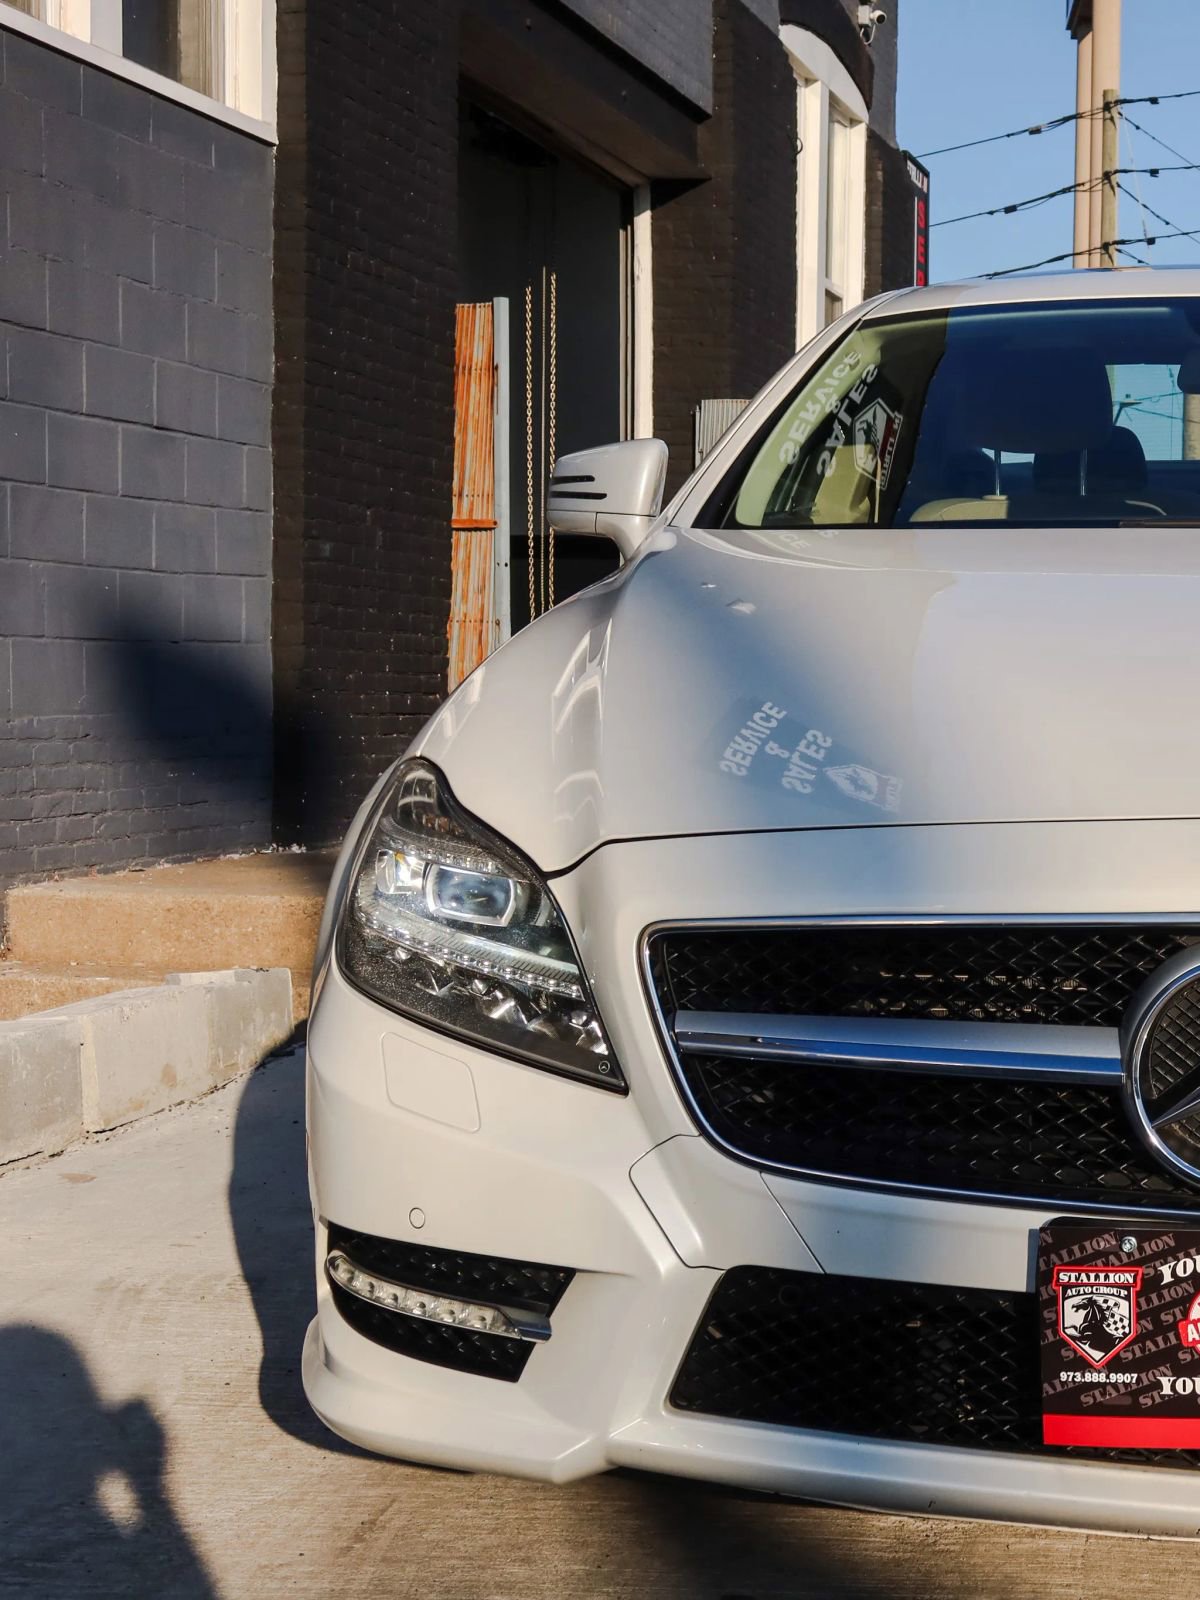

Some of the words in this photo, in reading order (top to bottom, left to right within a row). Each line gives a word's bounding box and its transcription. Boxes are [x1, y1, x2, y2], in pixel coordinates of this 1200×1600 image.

[1058, 1271, 1136, 1284] STALLION
[1065, 1286, 1092, 1298] AUTO
[1092, 1286, 1128, 1298] GROUP
[1060, 1371, 1138, 1384] 973.888.9907
